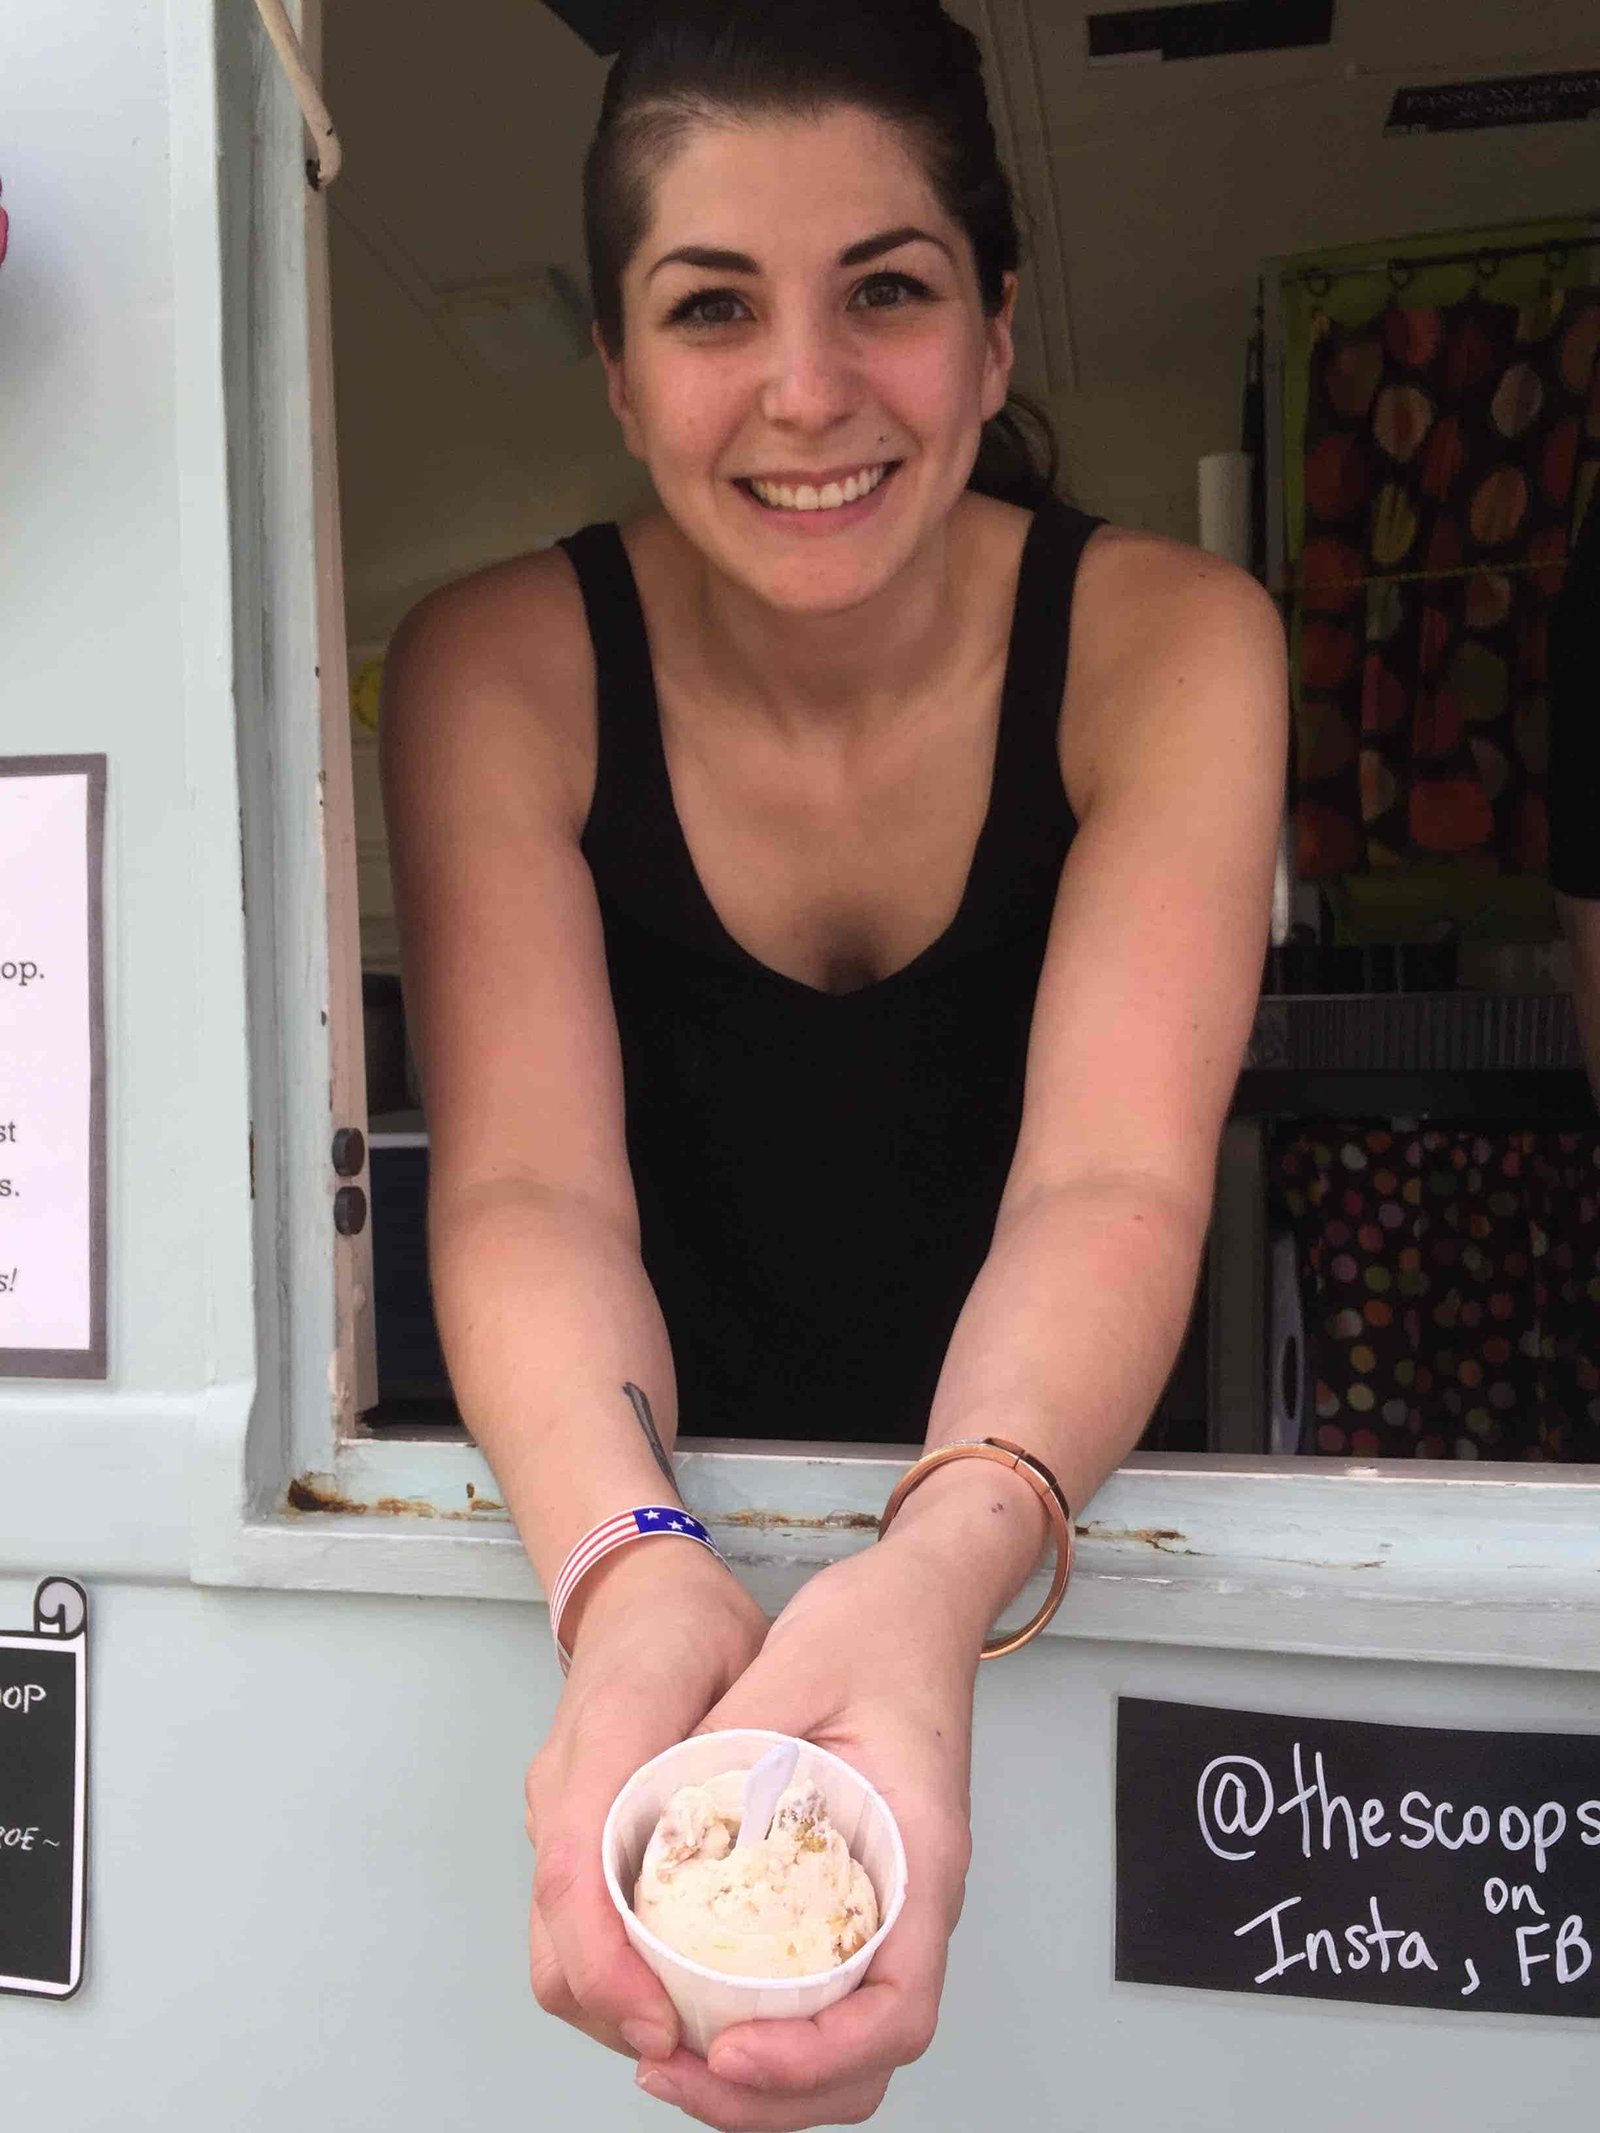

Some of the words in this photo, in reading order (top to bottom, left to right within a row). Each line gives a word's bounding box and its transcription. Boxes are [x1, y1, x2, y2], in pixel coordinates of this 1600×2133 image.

[0, 1684, 47, 1714] OP
[1197, 1742, 1600, 1874] @thescoops
[1484, 1876, 1545, 1916] on
[1515, 1915, 1593, 1986] FB
